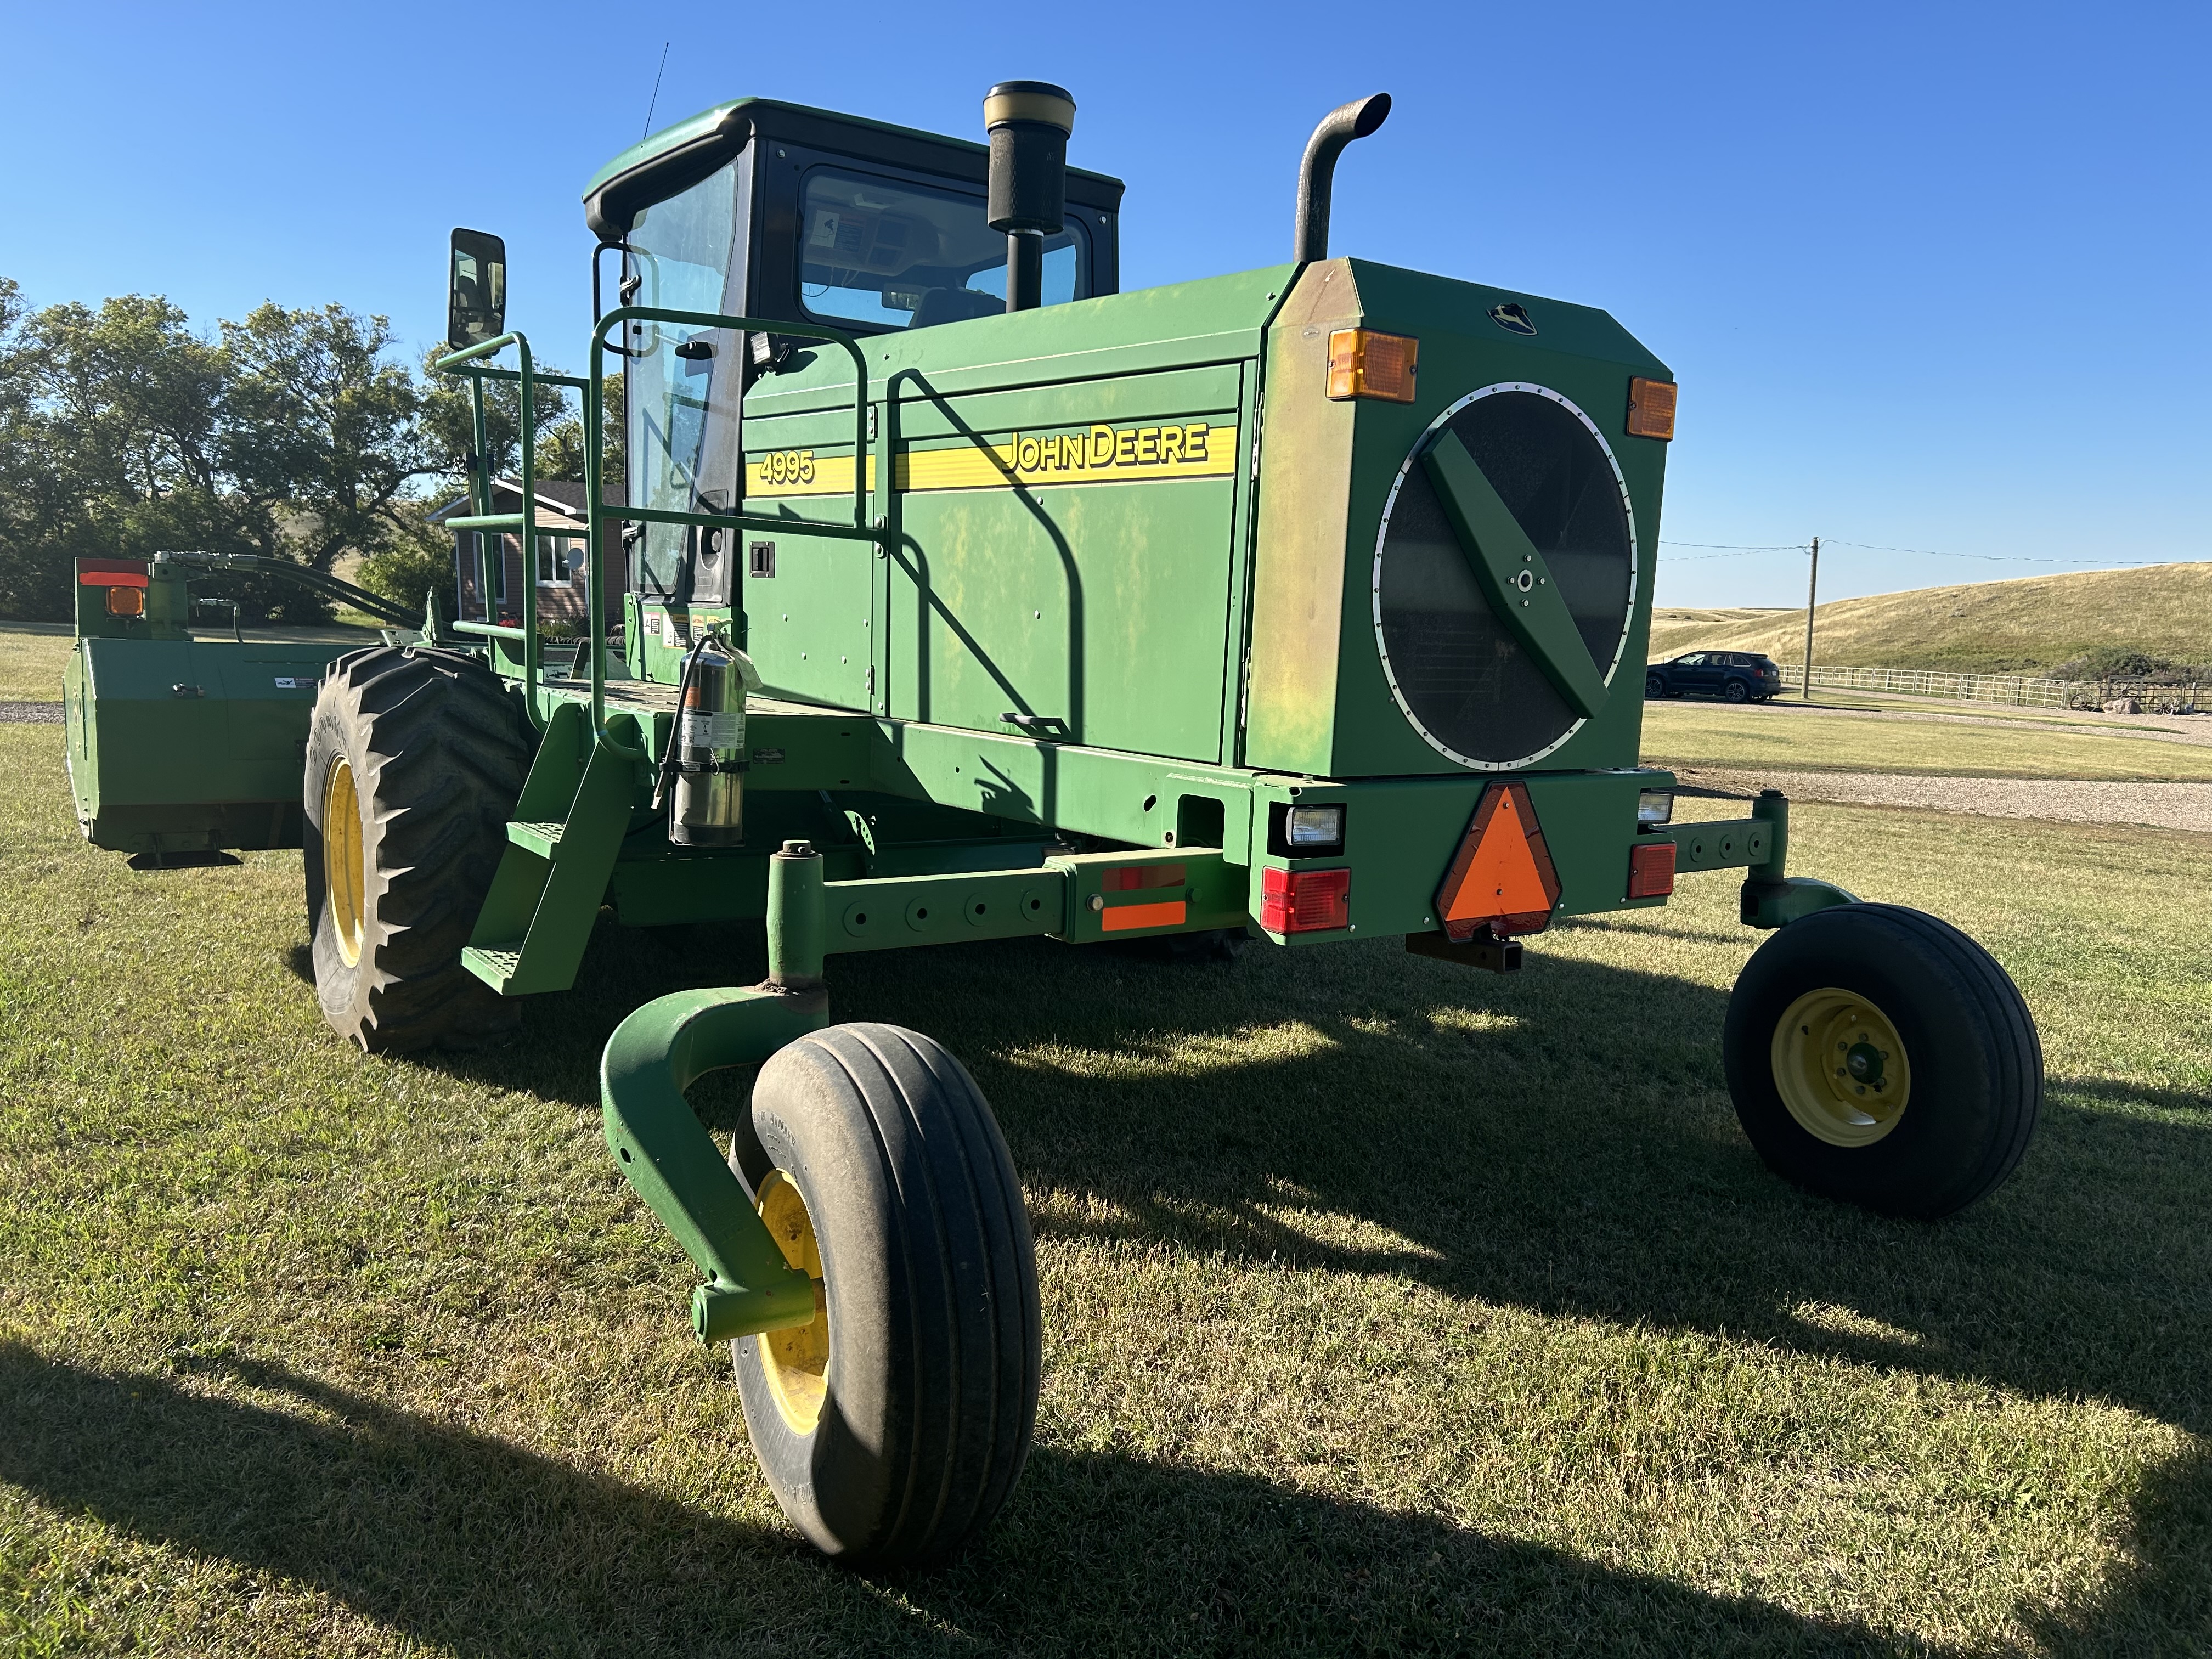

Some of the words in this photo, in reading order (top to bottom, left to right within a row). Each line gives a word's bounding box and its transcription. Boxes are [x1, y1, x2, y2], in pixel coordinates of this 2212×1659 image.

[760, 450, 815, 485] 4995
[1002, 431, 1086, 473] JOHN
[1090, 423, 1209, 468] DEERE
